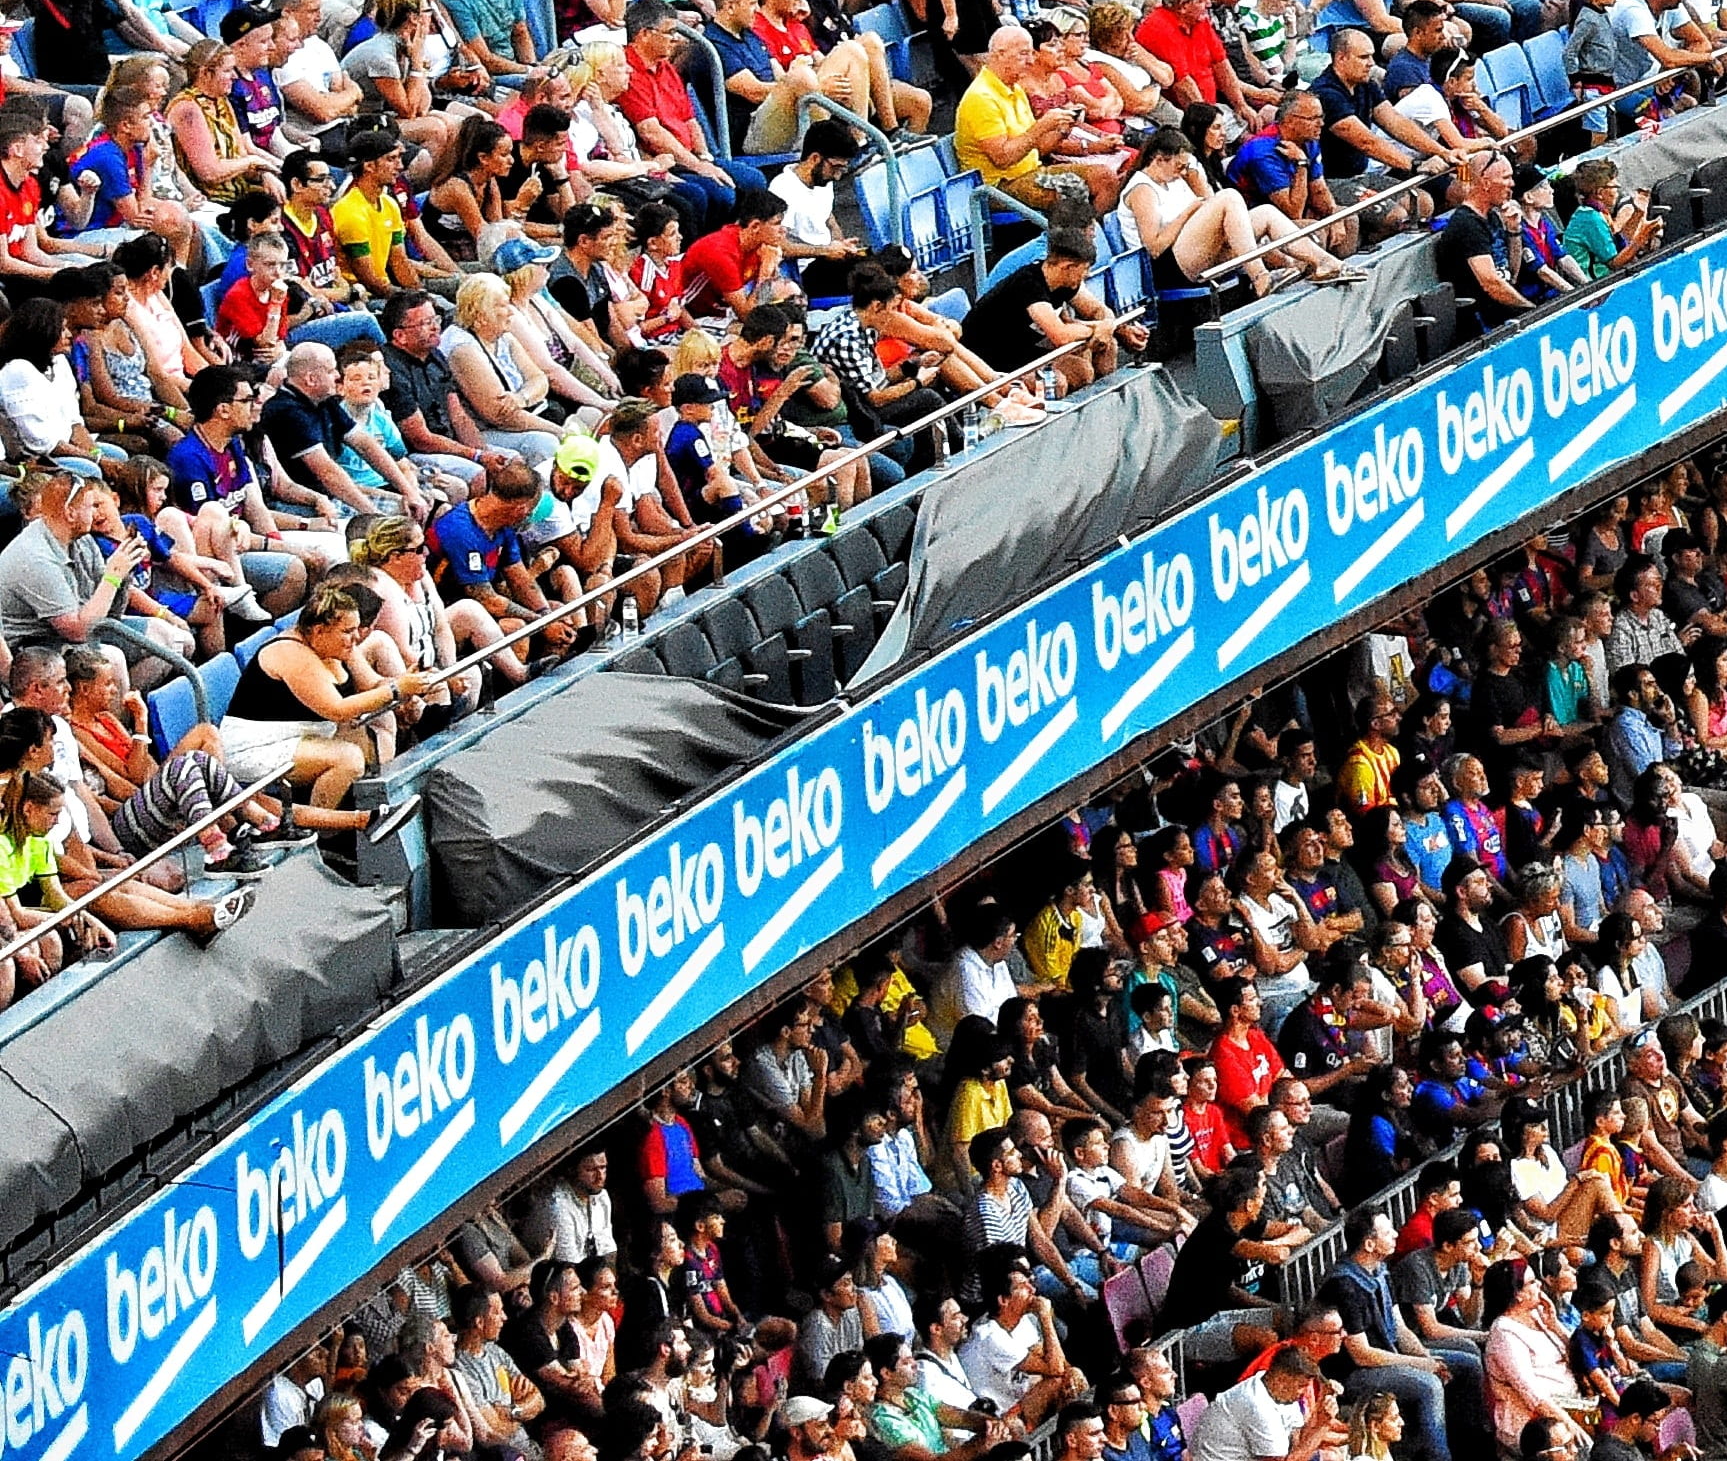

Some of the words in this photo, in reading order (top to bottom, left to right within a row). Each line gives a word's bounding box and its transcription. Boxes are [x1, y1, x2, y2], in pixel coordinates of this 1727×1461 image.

[0, 1309, 87, 1457] eko
[107, 1205, 218, 1364] beko
[237, 1108, 347, 1260] beko
[364, 1013, 475, 1161] beko
[491, 924, 601, 1065] beko
[616, 841, 724, 978] beko
[734, 766, 842, 898] beko
[863, 687, 967, 814] beko
[975, 619, 1078, 743] beko
[1092, 550, 1194, 672] beko
[1208, 485, 1309, 603] beko
[1323, 423, 1424, 537] beko
[1436, 364, 1534, 476] beko
[1540, 311, 1637, 419] beko
